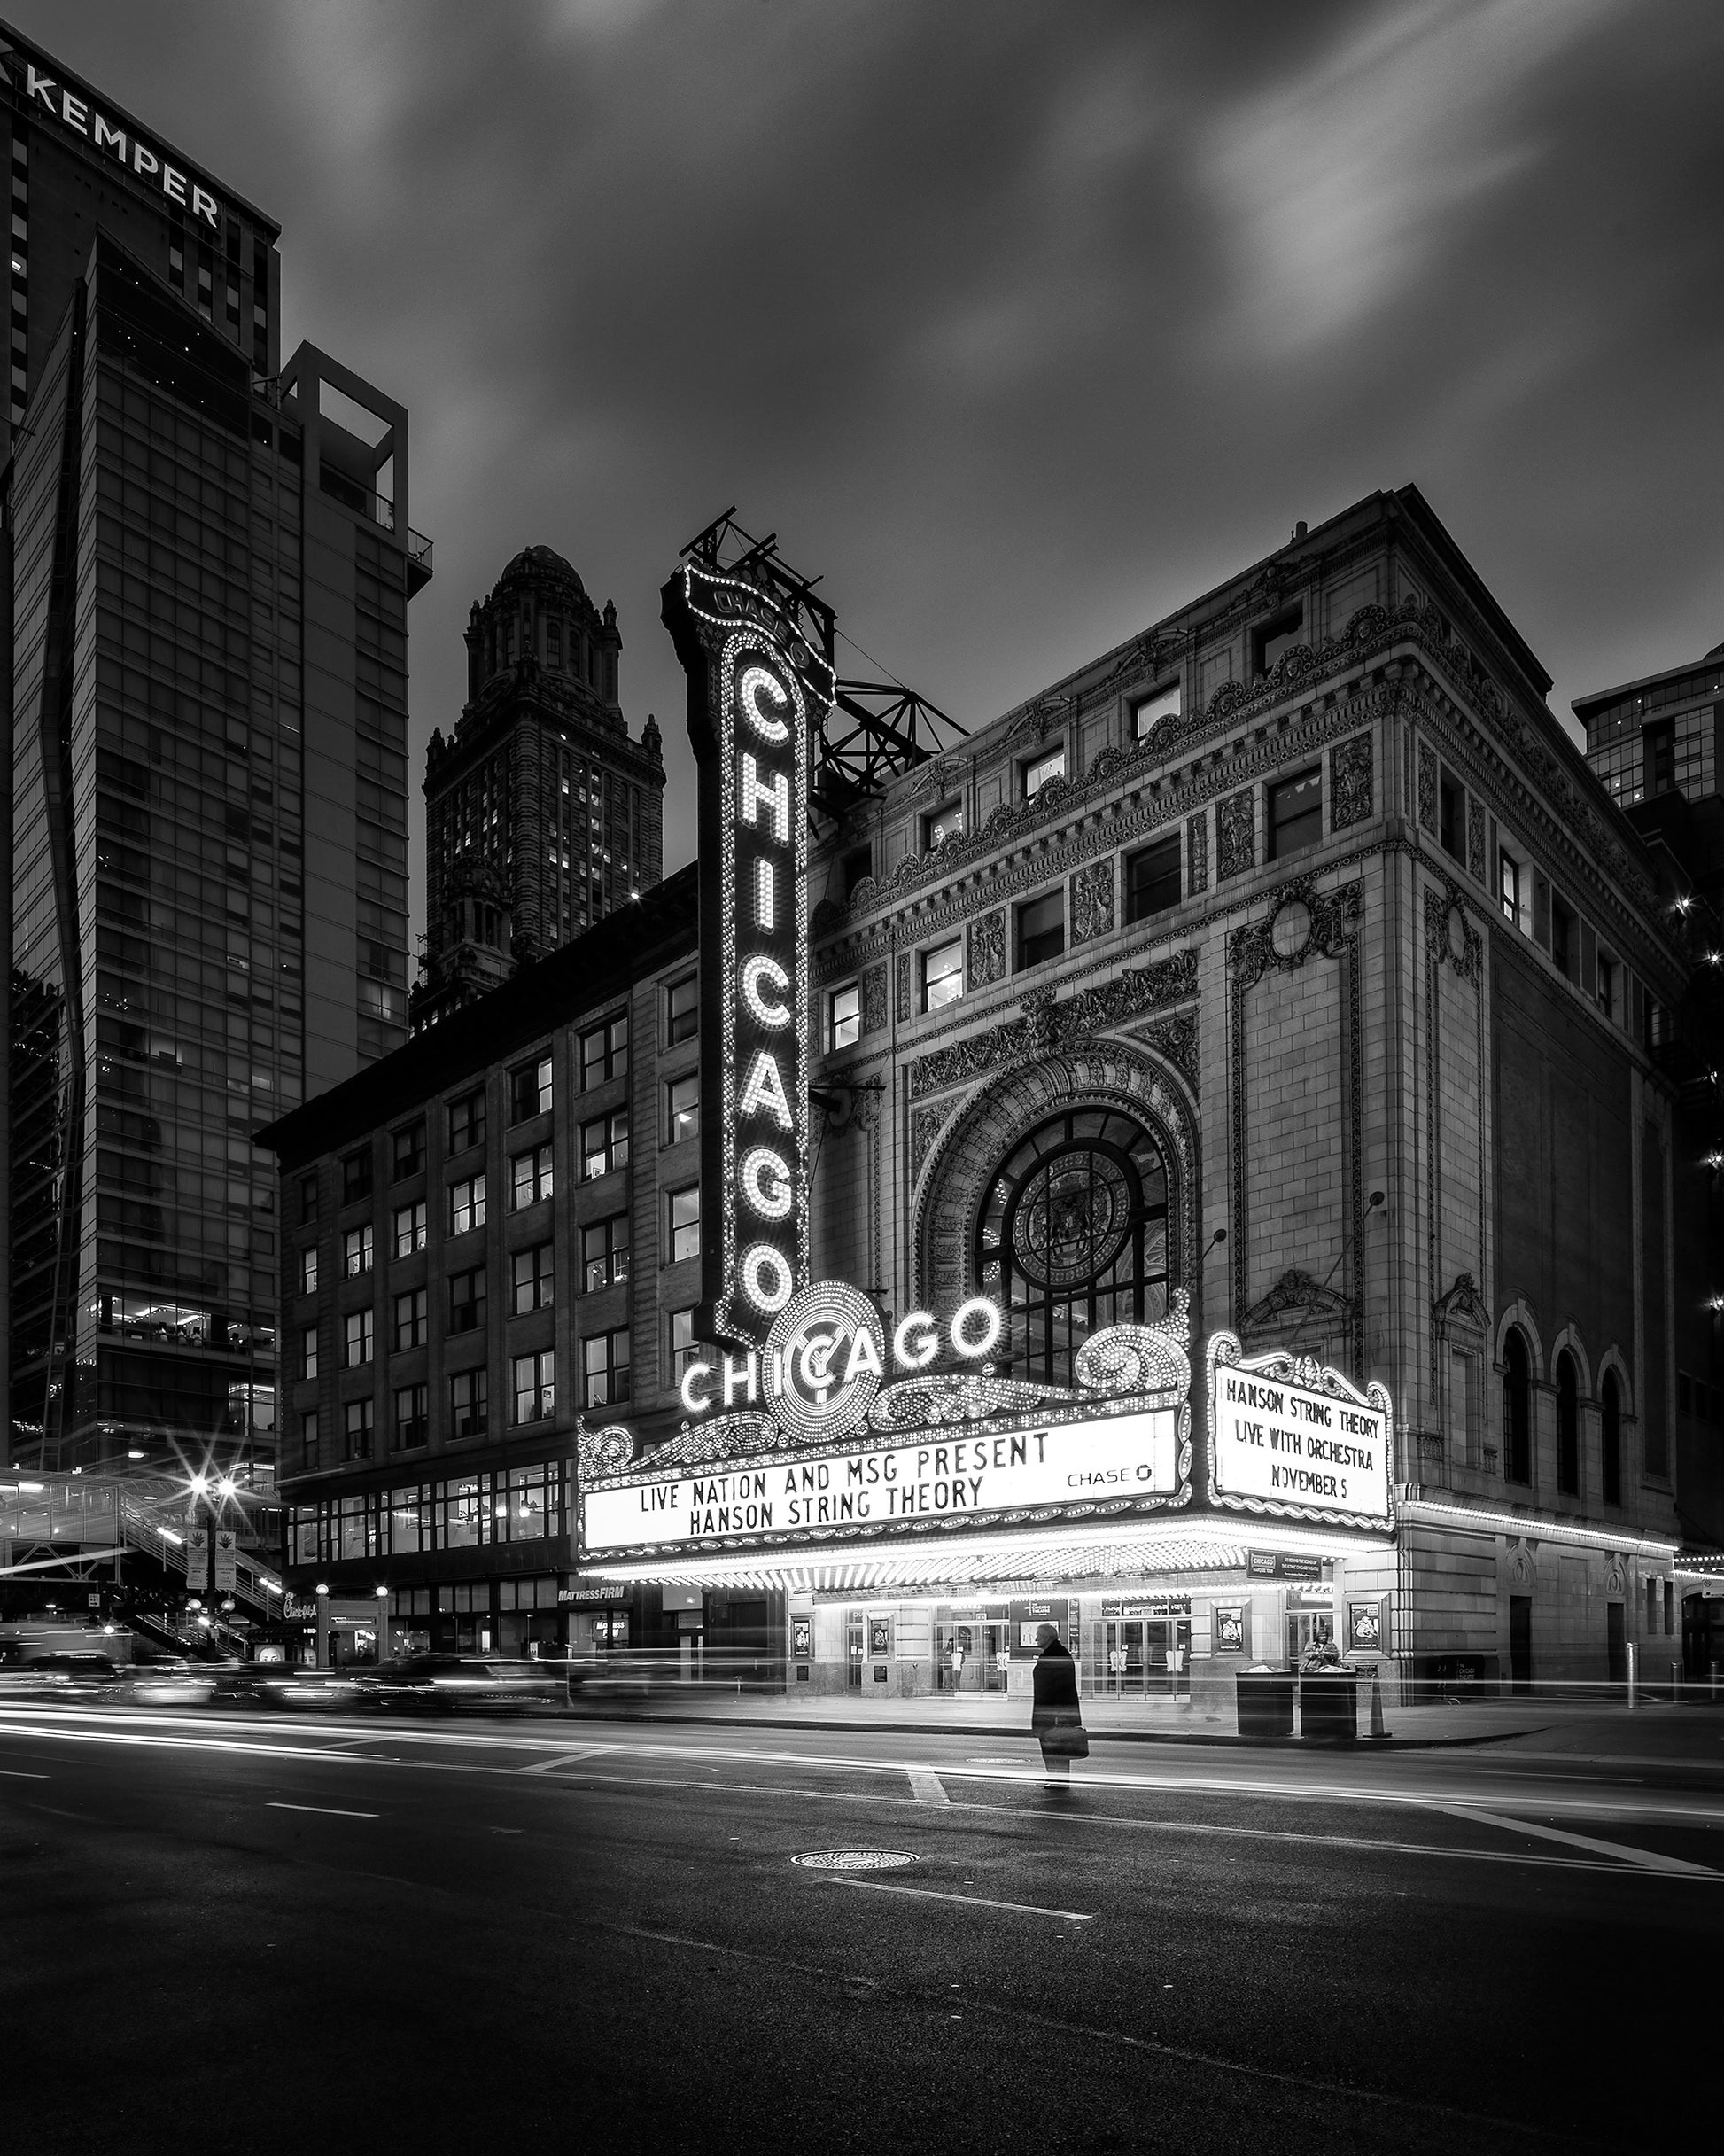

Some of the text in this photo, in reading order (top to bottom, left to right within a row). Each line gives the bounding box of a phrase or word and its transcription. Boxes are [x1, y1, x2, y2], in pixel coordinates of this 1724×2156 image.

[27, 64, 218, 228] KEMPER
[713, 590, 790, 646] CHASE
[740, 666, 794, 1315] CHICAGO
[680, 1296, 1001, 1413] CHICAGO
[1227, 1378, 1378, 1439] HANSON STRING THEORY
[641, 1432, 1049, 1512] LIVE NATION AND MSG PRESENT
[1235, 1419, 1373, 1471] LIVE WITH ORCHESTRA
[690, 1476, 983, 1535] HANSON STRING THEORY
[1068, 1467, 1130, 1487] CHASE
[1271, 1464, 1338, 1498] NOVEMBER
